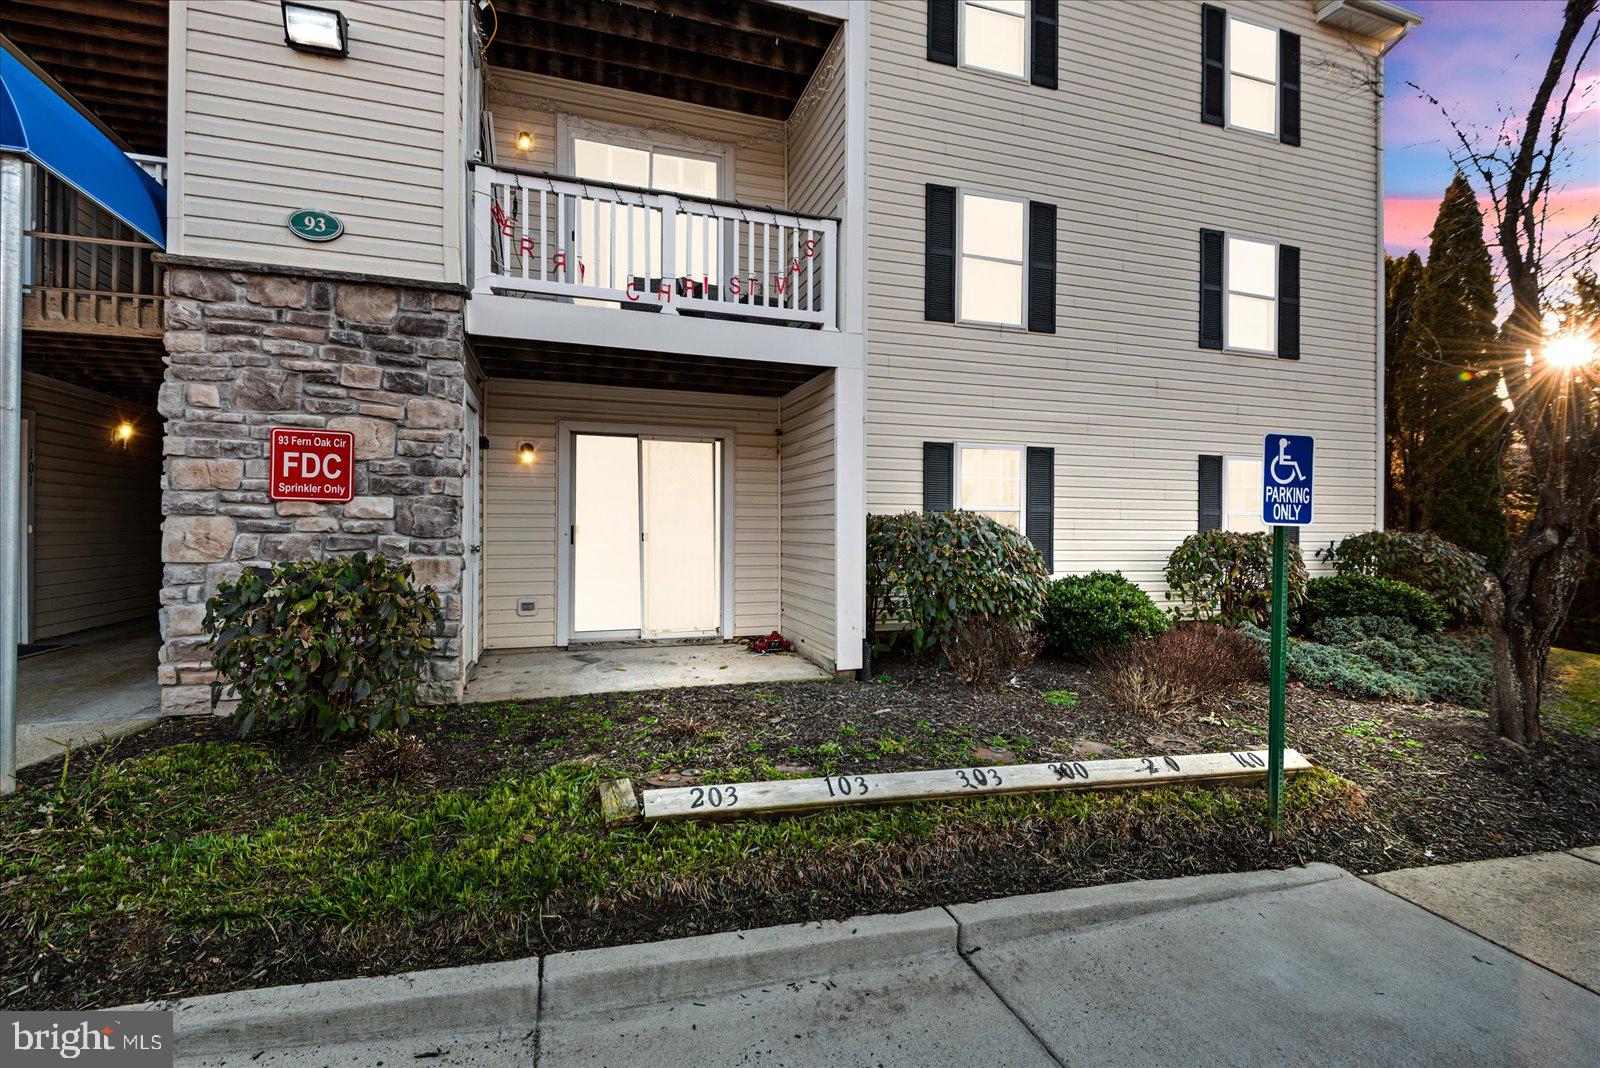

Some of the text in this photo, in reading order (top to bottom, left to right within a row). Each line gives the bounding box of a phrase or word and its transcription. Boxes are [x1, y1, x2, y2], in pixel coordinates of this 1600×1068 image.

[304, 216, 326, 232] 93
[626, 239, 816, 303] CHRISTMAS
[278, 435, 346, 448] 93 Fern Oak Cir
[283, 451, 342, 479] FDC
[278, 482, 346, 496] Sprinkler Only
[1265, 485, 1310, 504] PARKING
[1273, 503, 1302, 520] ONLY
[689, 786, 739, 809] 203
[823, 775, 869, 798] 103
[955, 768, 1003, 788] 303
